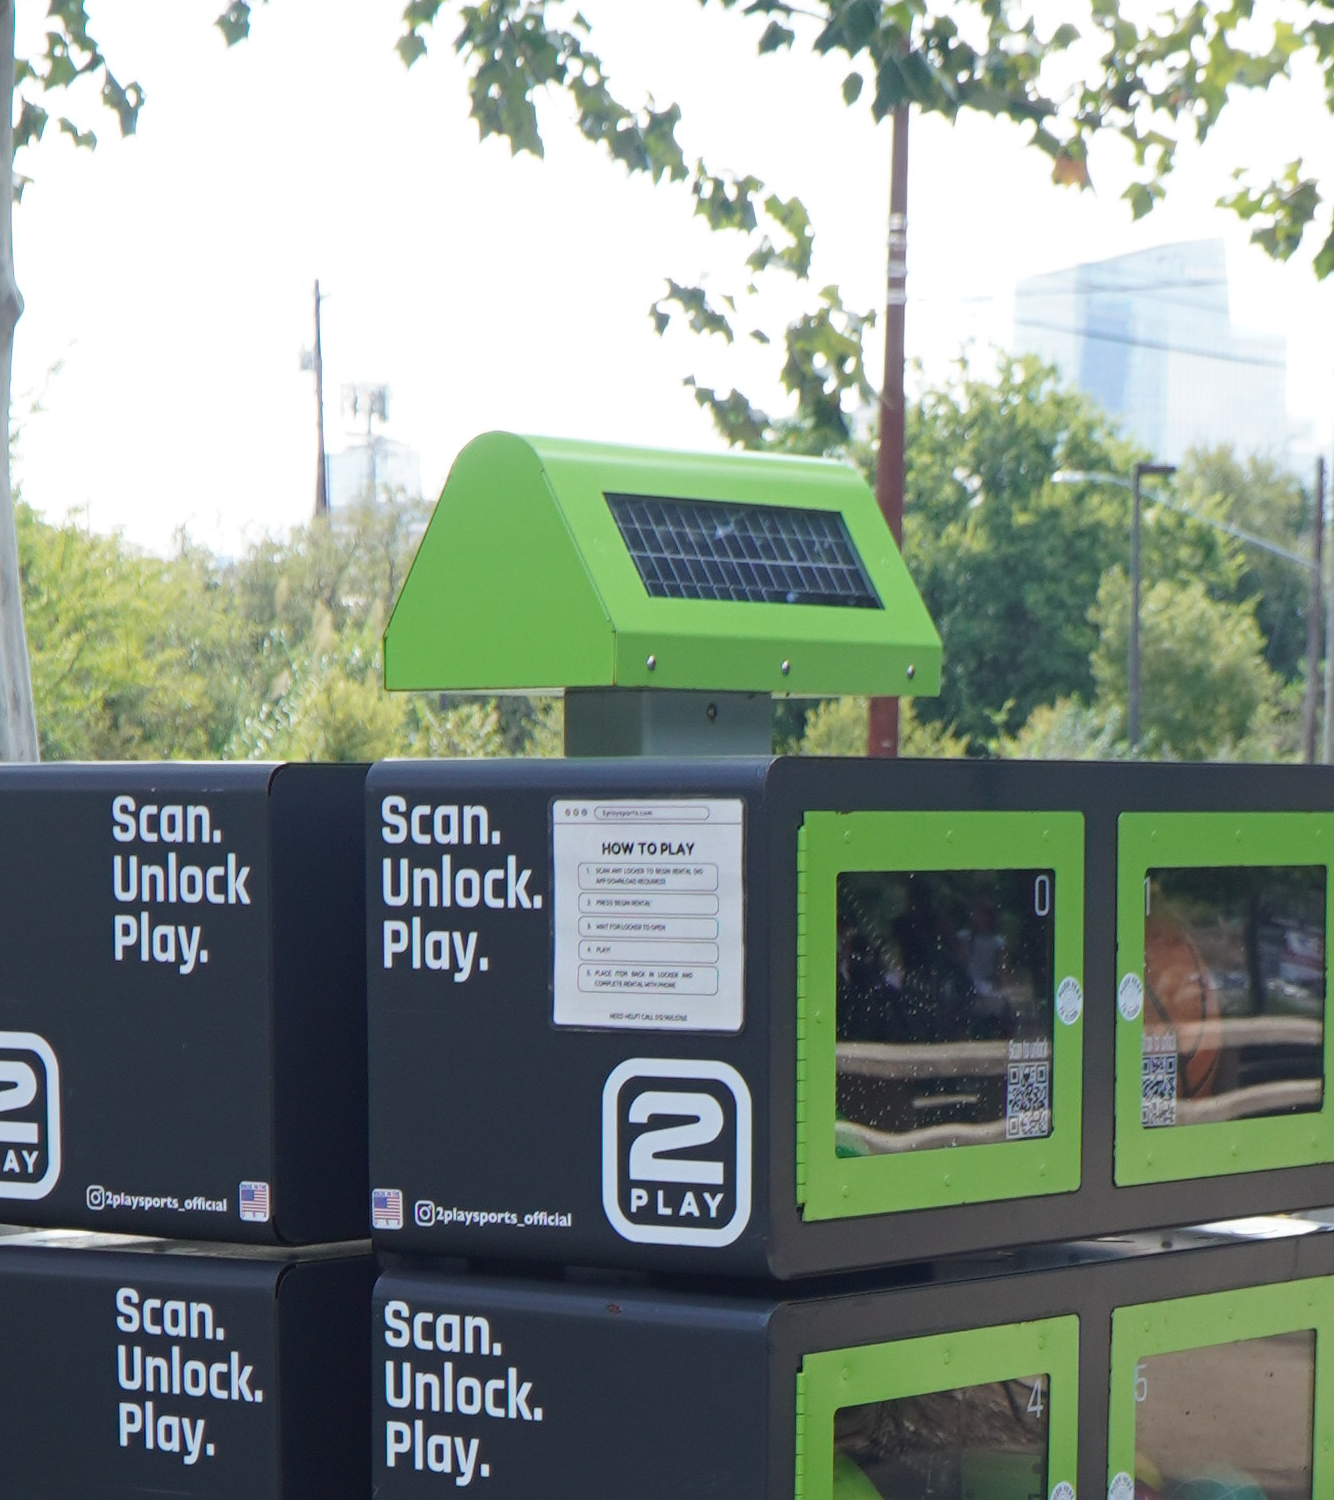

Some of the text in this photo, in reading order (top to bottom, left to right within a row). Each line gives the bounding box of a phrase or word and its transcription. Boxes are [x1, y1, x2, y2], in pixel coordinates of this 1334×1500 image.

[112, 795, 222, 844] Scan.
[381, 795, 501, 845] Scan.
[602, 842, 695, 855] HOW TO PLAY
[113, 851, 251, 905] Unlock
[382, 854, 543, 909] Unlock.
[114, 911, 209, 975] Play.
[383, 916, 489, 983] Play.
[628, 1090, 724, 1185] 2
[105, 1191, 228, 1212] 2playsports_official
[435, 1206, 572, 1227] 2playsports_official
[630, 1187, 724, 1218] PLAY
[116, 1287, 225, 1341] Scan.
[384, 1300, 502, 1356] Scan.
[117, 1344, 263, 1403] Unlock.
[385, 1360, 543, 1421] Unlock.
[1026, 1378, 1044, 1418] 4
[119, 1400, 215, 1465] Play.
[386, 1419, 490, 1487] Play.
